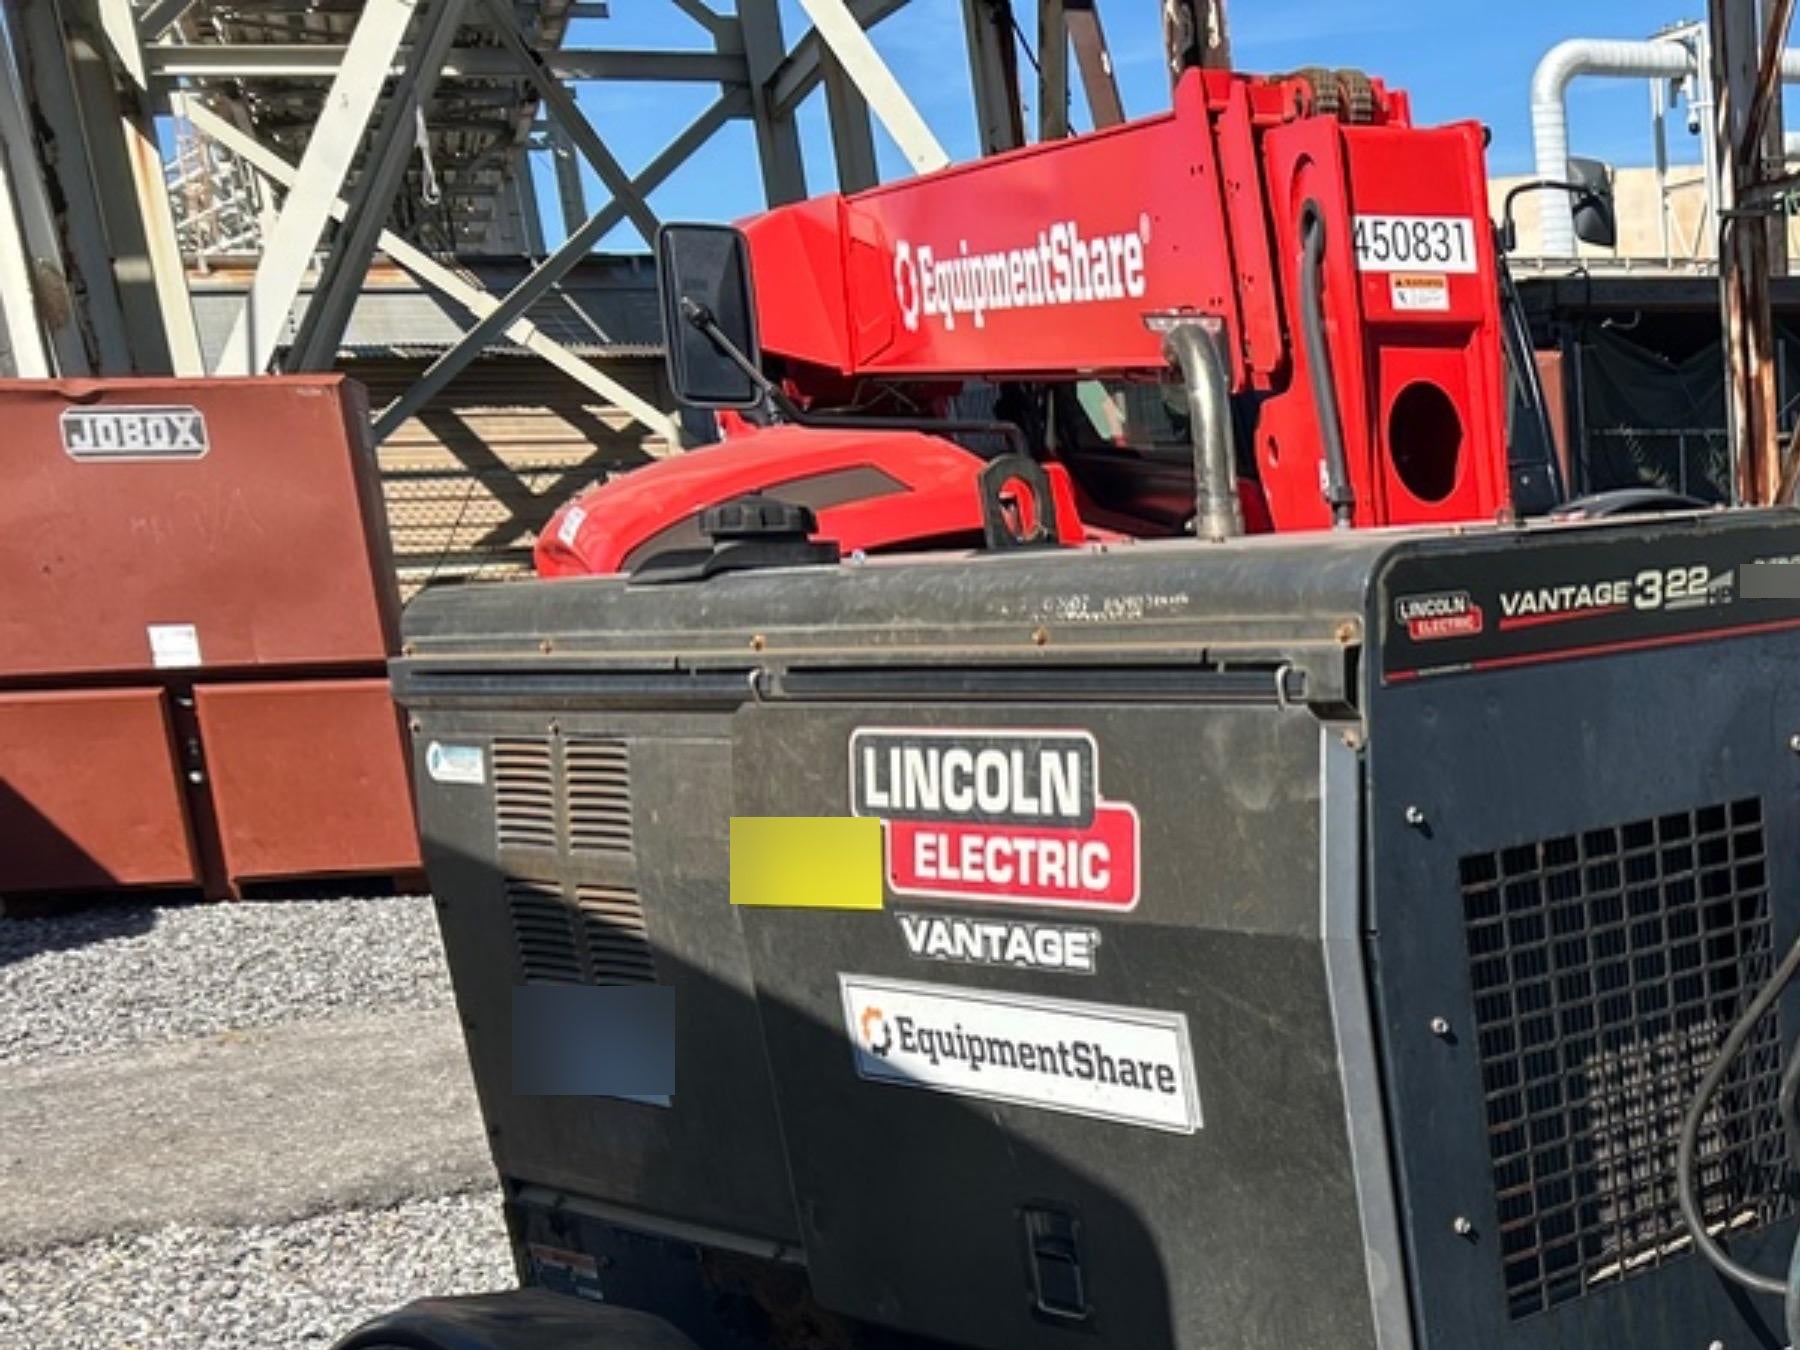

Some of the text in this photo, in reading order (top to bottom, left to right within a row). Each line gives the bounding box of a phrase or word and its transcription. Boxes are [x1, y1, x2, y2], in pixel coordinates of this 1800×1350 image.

[1354, 219, 1468, 263] 450831
[916, 221, 1147, 331] EquipmentShare
[69, 415, 203, 449] JOBOX
[1400, 595, 1467, 620] LINCOLN
[1499, 581, 1630, 617] VANTAGE
[1634, 565, 1710, 611] 322
[863, 745, 1082, 817] LINCOLN
[913, 831, 1112, 891] ELECTRIC
[899, 916, 1092, 969] VANTAGE
[893, 1015, 1179, 1095] EquipmentShare
